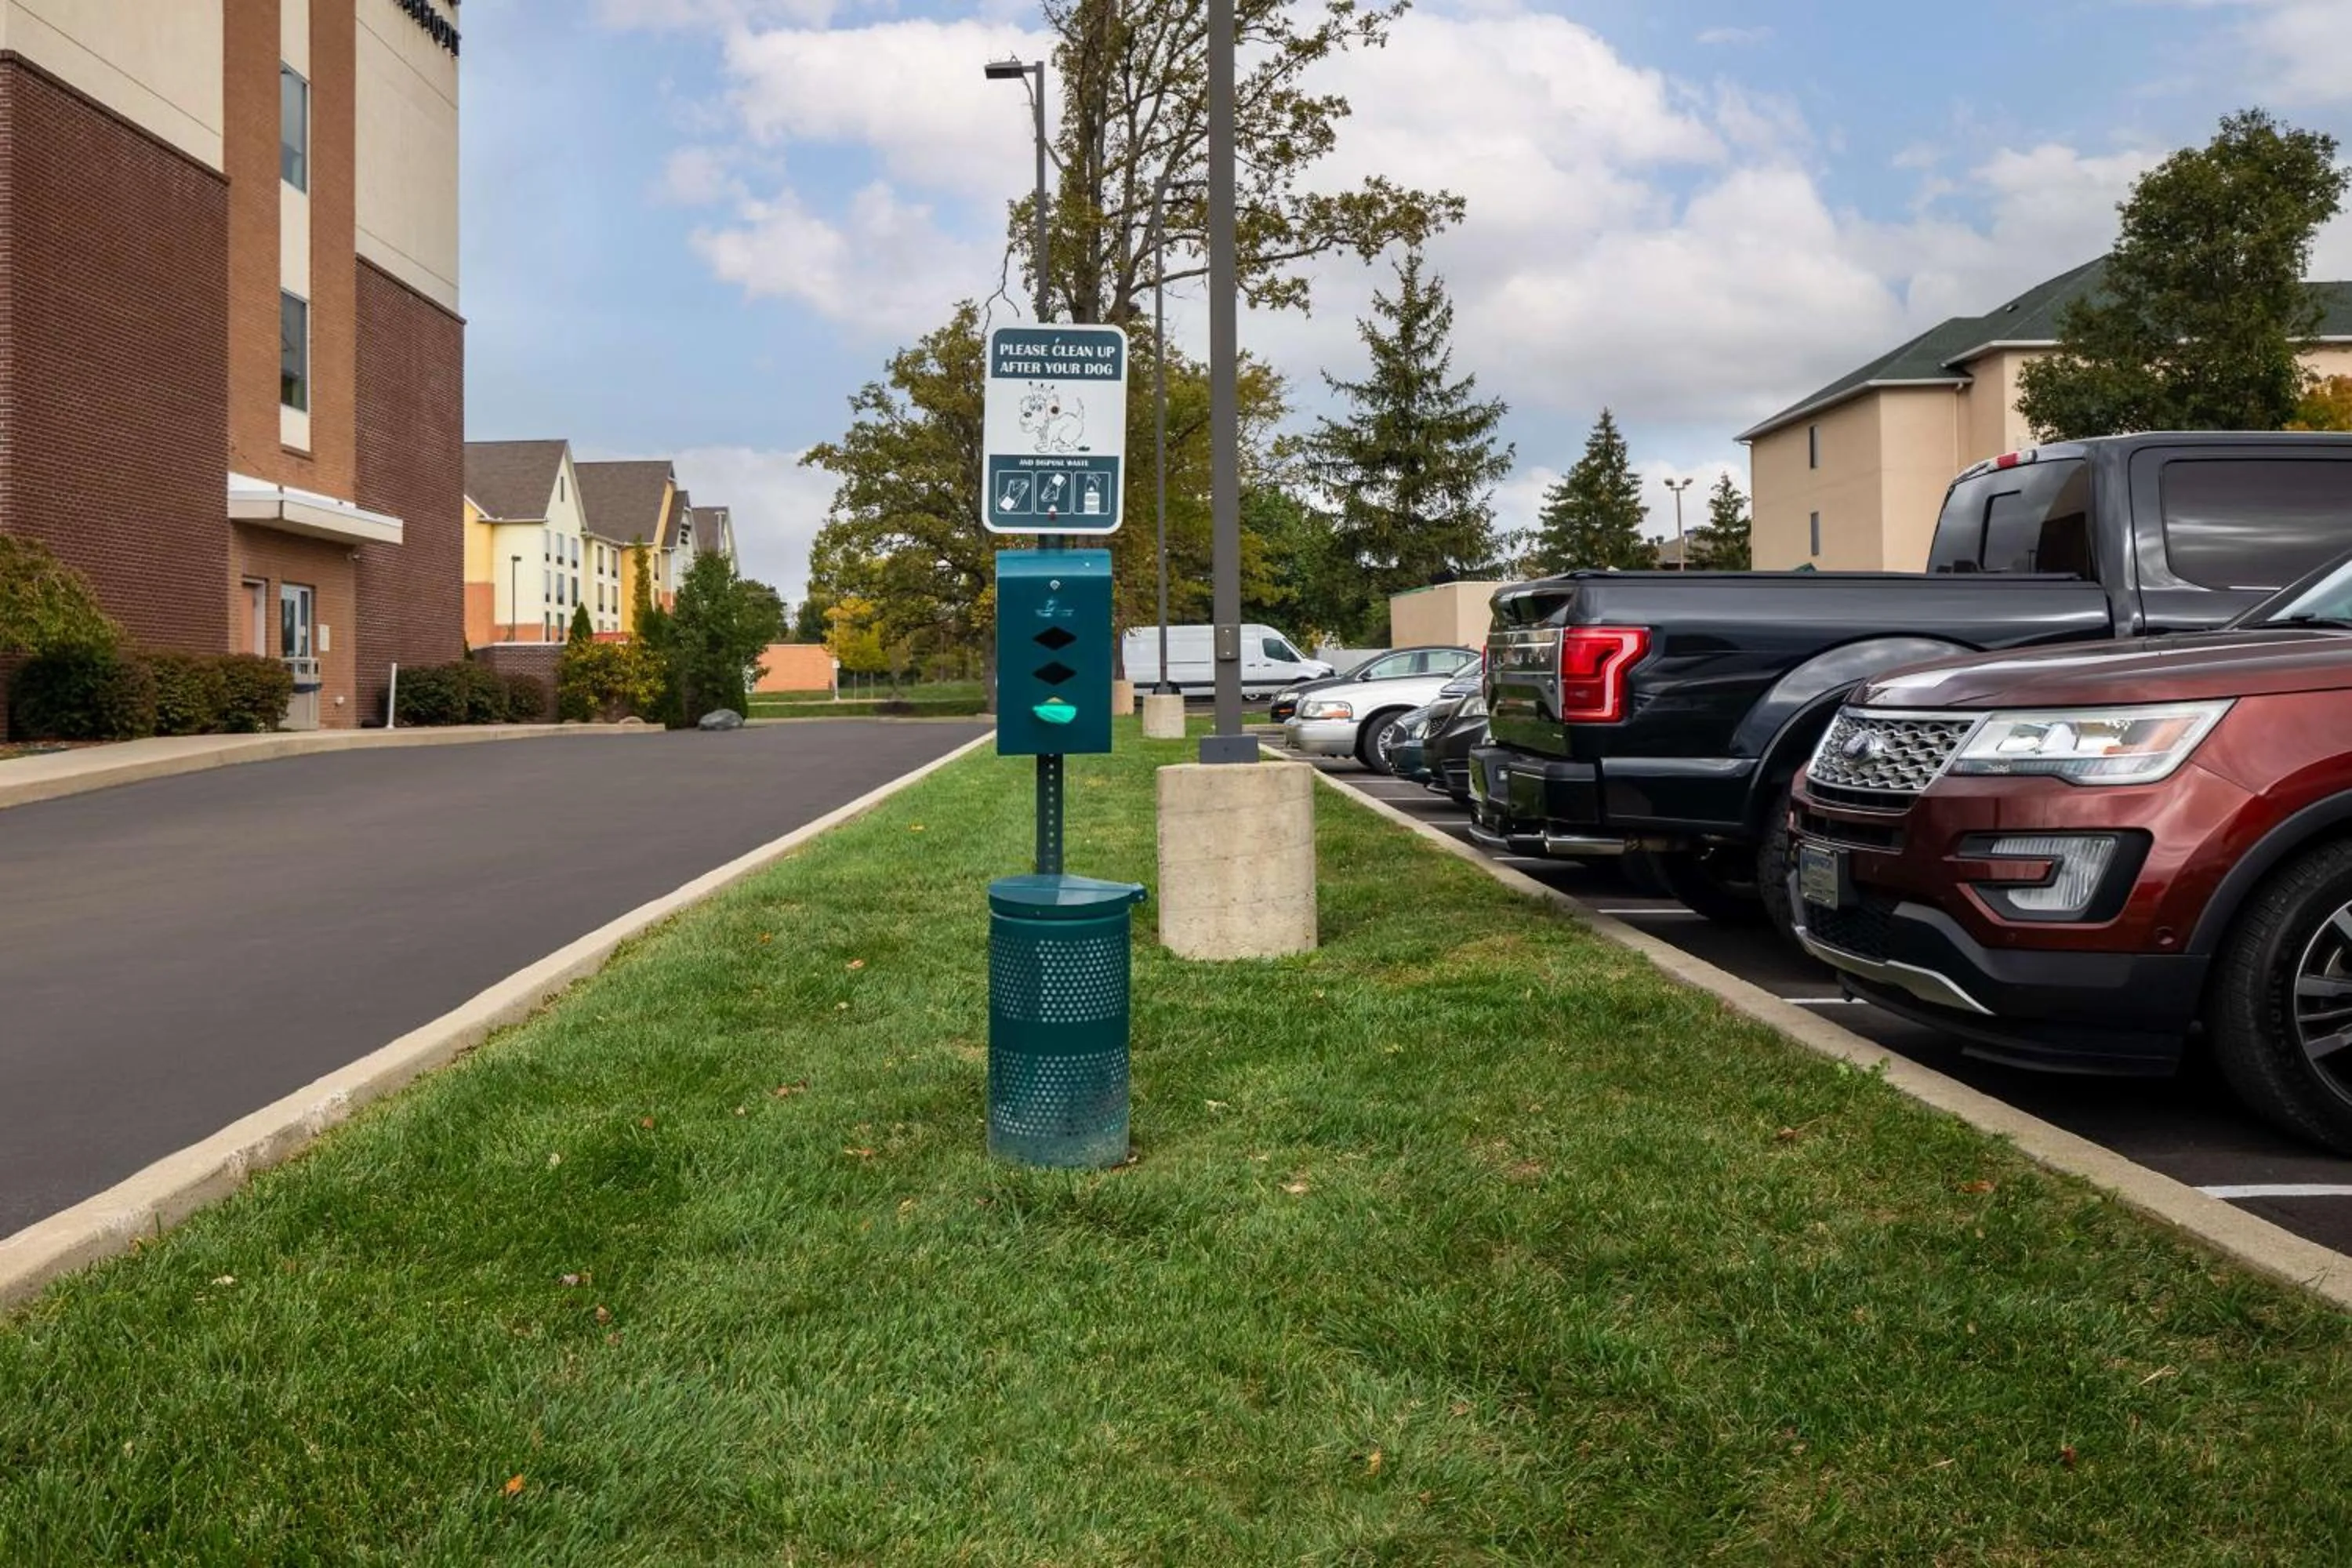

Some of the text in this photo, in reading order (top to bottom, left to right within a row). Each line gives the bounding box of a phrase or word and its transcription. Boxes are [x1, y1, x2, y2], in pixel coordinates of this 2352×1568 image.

[1000, 343, 1116, 358] PLEASE CLEAN UP
[1000, 361, 1113, 376] AFTER YOUR DOG
